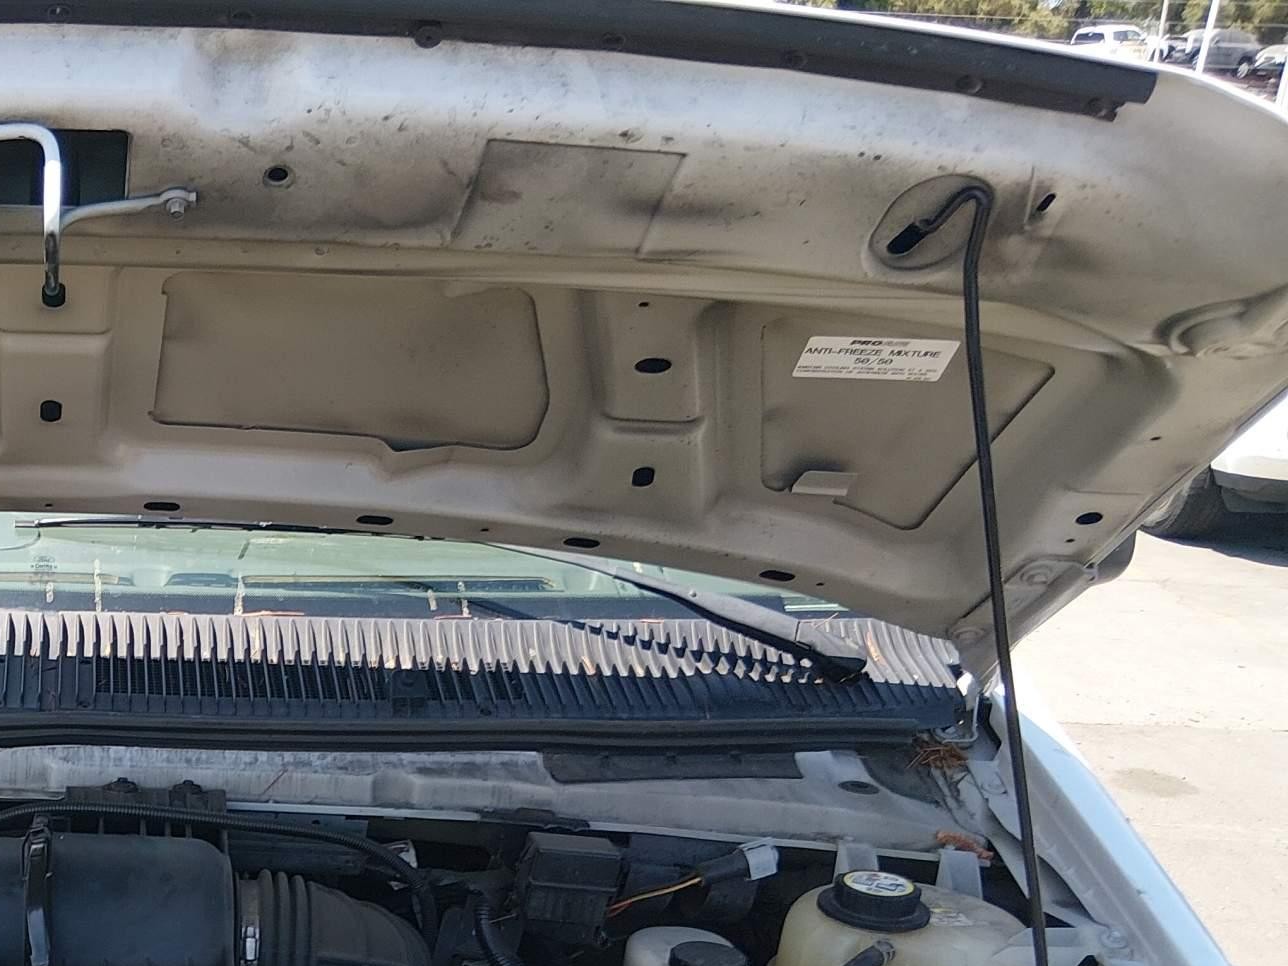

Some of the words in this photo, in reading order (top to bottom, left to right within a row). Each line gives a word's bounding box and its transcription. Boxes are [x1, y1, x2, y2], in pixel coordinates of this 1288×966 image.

[804, 347, 882, 356] ANTI-FREEZE
[888, 350, 941, 358] MIXTURE
[854, 357, 893, 366] 50/50
